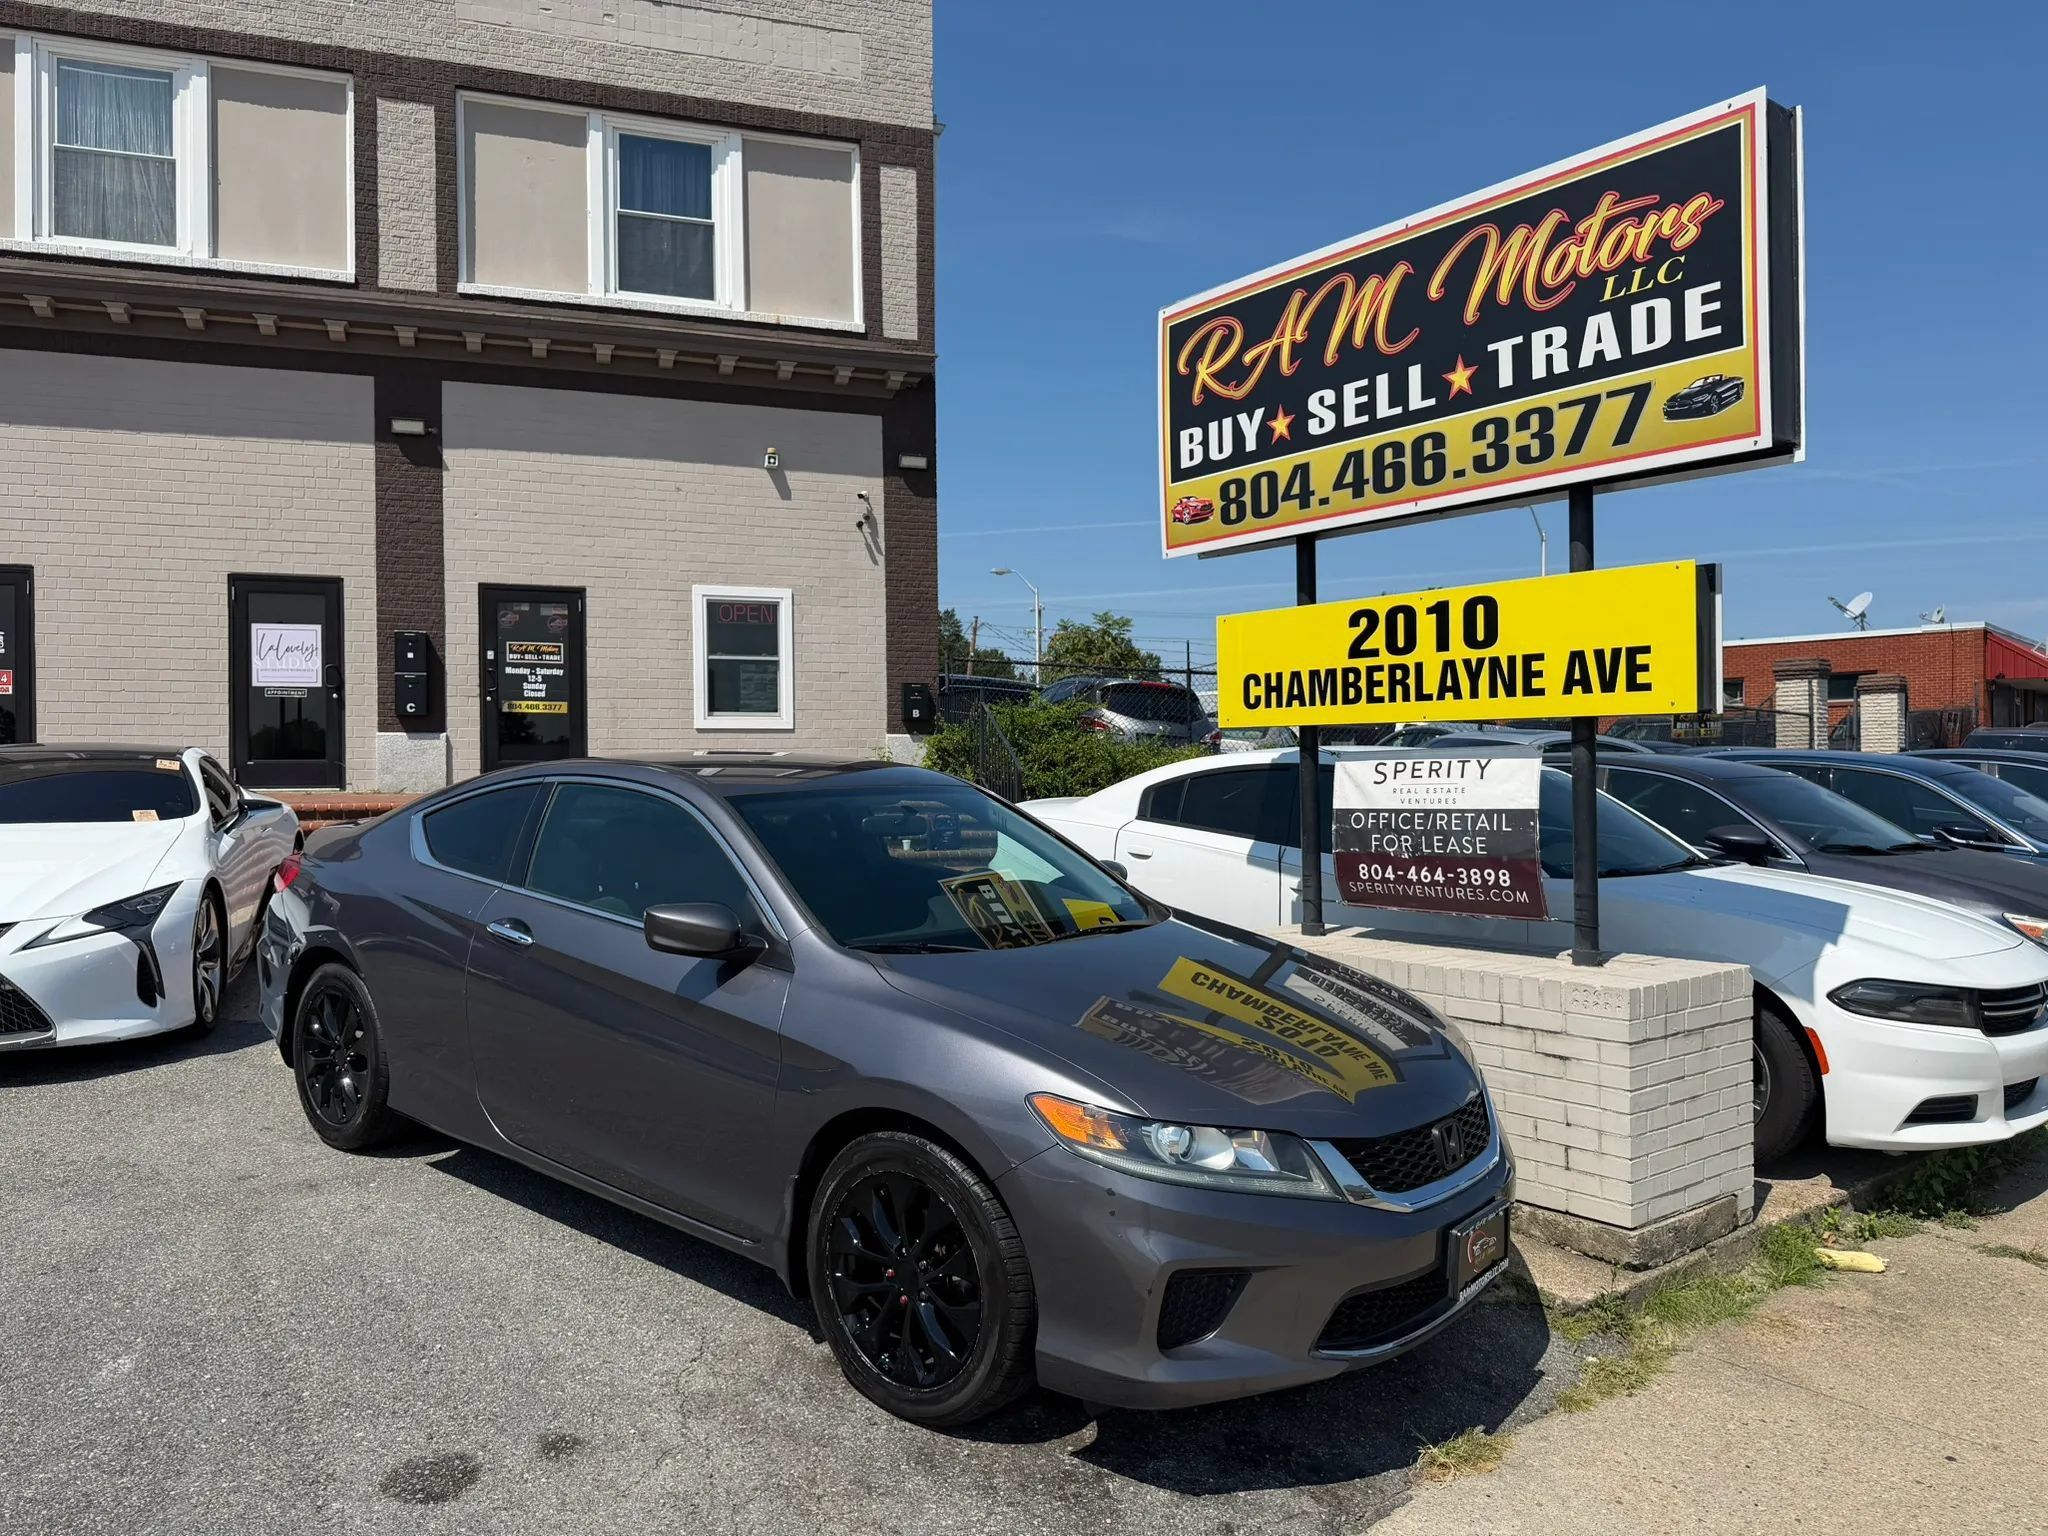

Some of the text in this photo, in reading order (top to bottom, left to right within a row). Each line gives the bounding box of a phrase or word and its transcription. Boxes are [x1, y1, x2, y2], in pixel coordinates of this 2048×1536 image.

[1600, 255, 1685, 302] LLC
[1177, 191, 1724, 406] RAM Motors
[1179, 281, 1722, 469] BUY SELL TRADE
[1219, 379, 1655, 525] 804.466.3377
[720, 604, 774, 623] OPEN
[1347, 595, 1499, 660] 2010
[505, 667, 530, 675] Monday
[536, 667, 564, 676] Saturday
[1243, 645, 1653, 710] CHAMBERLAYNE AVE
[523, 682, 546, 690] Sunday
[406, 703, 416, 713] C
[912, 709, 920, 718] B
[1373, 759, 1492, 785] SPERITY
[1351, 812, 1512, 831] OFFICE/RETAIL
[1371, 834, 1488, 854] FOR LEASE
[1358, 863, 1511, 887] 804-464-3898
[1349, 881, 1529, 903] SPERITYVENTURES.COM
